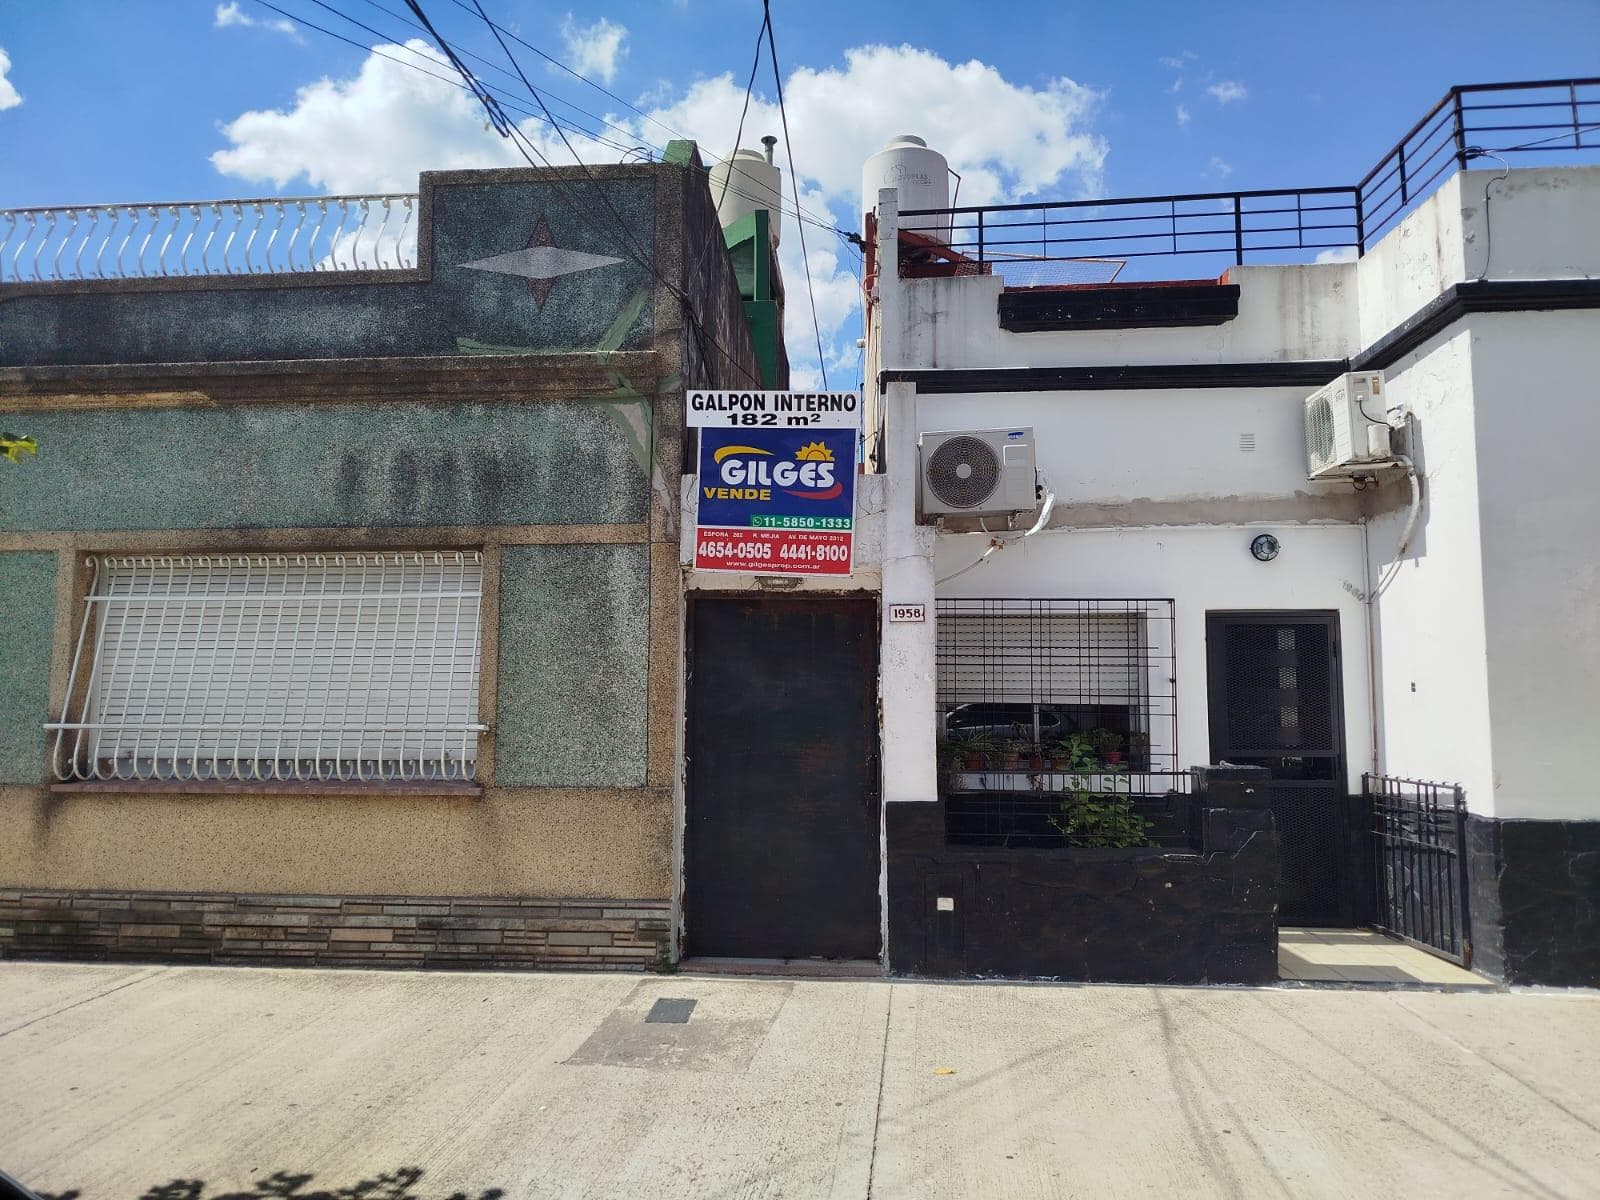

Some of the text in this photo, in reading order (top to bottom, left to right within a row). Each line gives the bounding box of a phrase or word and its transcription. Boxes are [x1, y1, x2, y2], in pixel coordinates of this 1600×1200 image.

[691, 393, 857, 412] GALPON INTERNO
[727, 413, 778, 426] 182
[720, 459, 835, 488] GILGES
[703, 487, 771, 500] VENDE
[763, 517, 851, 529] 11-5850-1333
[699, 541, 848, 561] 4654-0505 4441-8100
[726, 561, 820, 570] www.gilgesprop.com.ar
[894, 608, 921, 619] 1958
